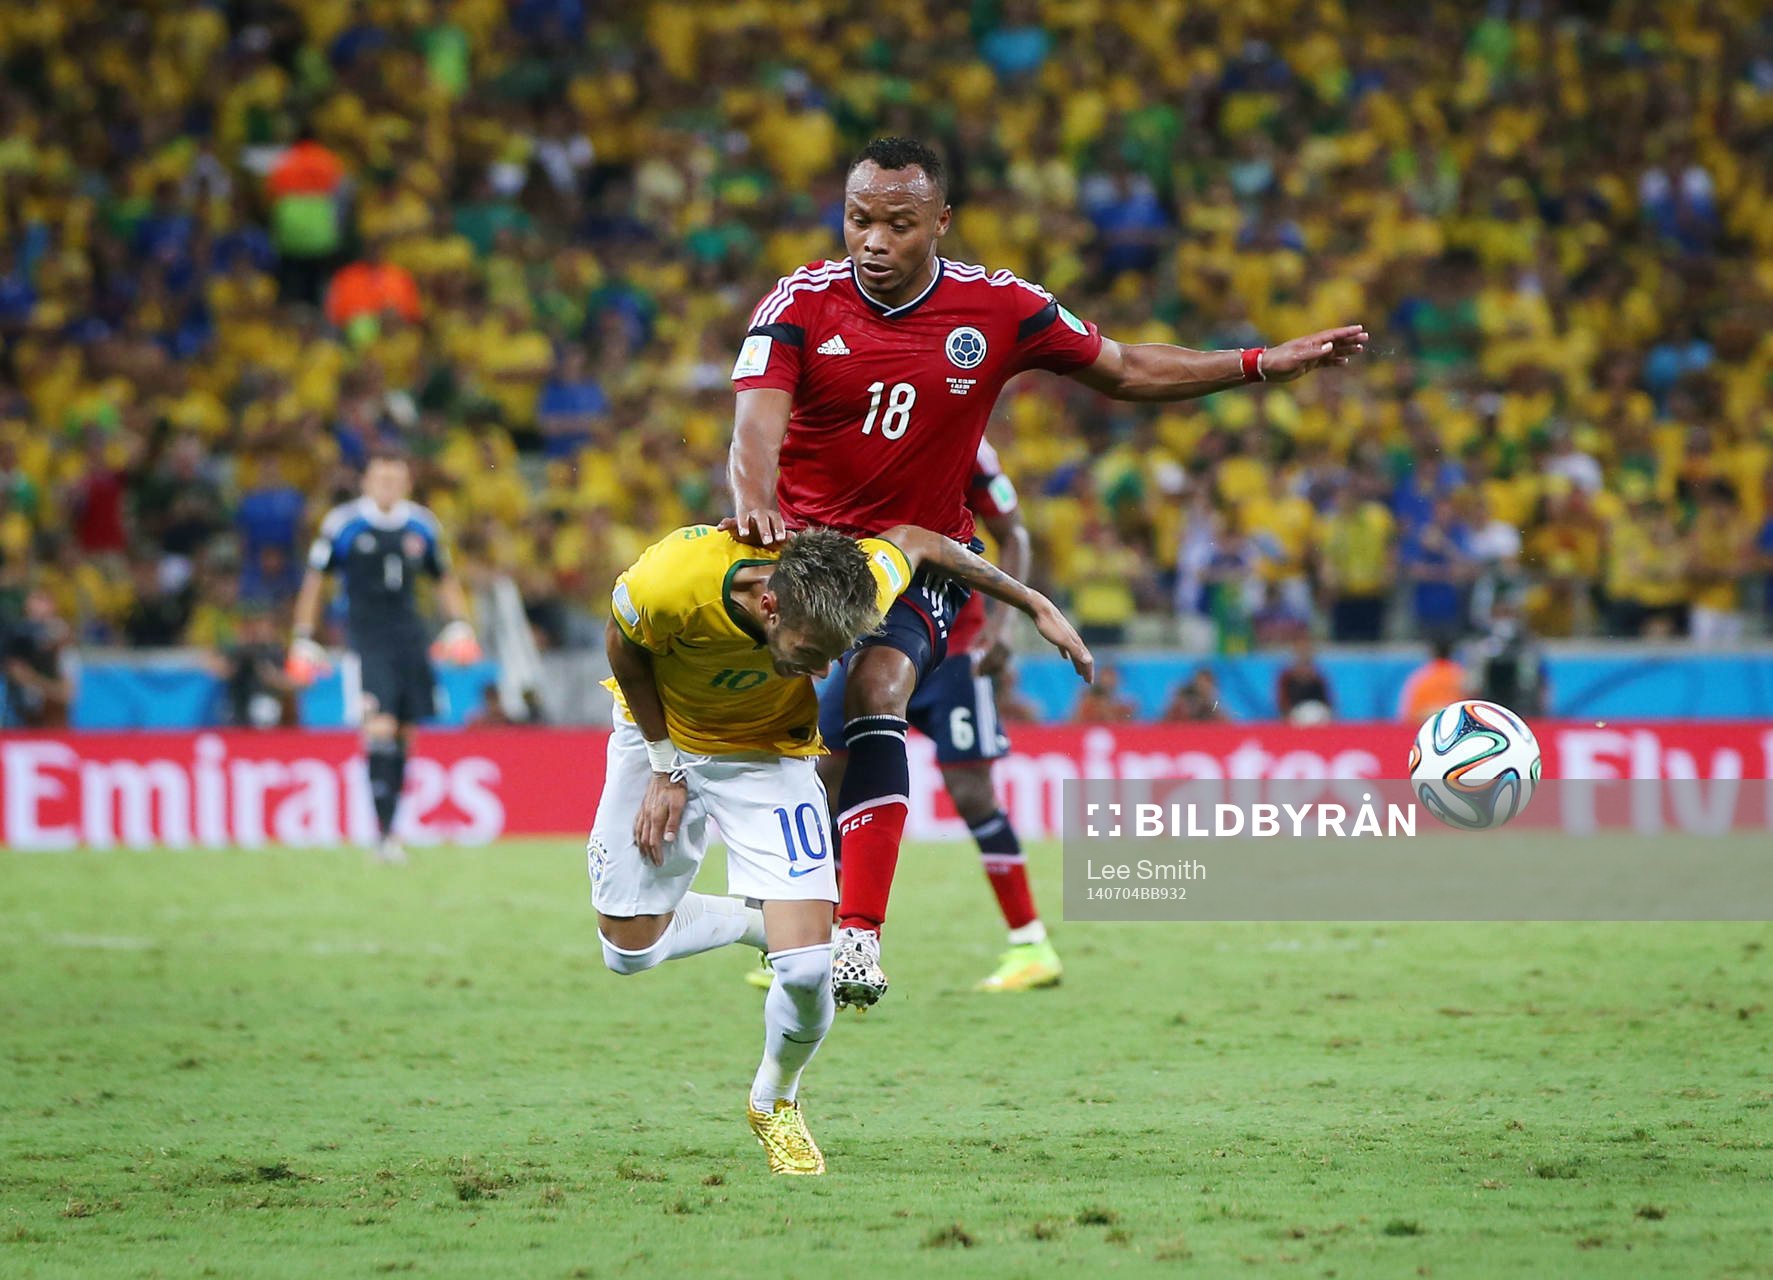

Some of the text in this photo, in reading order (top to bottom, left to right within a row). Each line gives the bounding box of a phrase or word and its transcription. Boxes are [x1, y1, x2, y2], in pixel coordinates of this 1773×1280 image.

[816, 345, 851, 356] adidas
[861, 381, 917, 440] 18
[711, 669, 769, 690] 10
[950, 706, 974, 751] 6
[773, 802, 828, 862] 10
